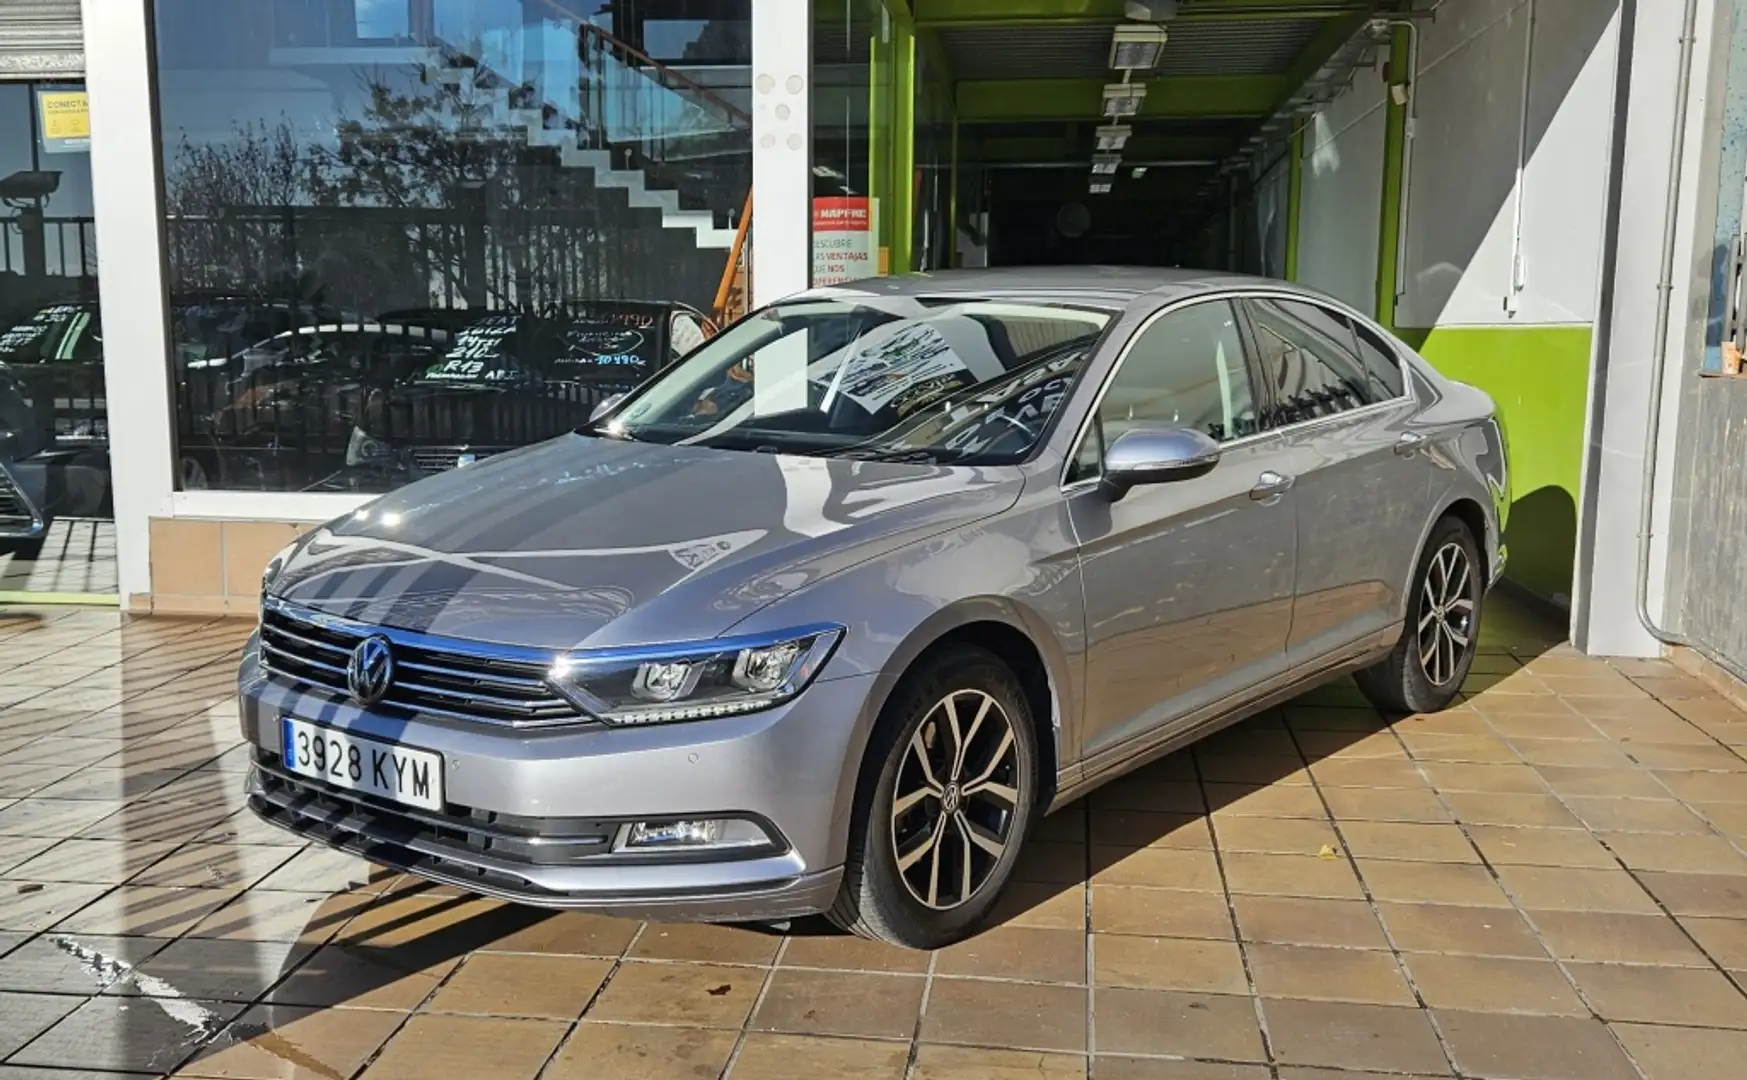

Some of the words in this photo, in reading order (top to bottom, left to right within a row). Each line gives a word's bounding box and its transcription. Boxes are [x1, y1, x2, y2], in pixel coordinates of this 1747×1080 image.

[820, 208, 867, 218] MAPFRE
[826, 251, 868, 262] VENTAJAS
[827, 263, 845, 273] NOS
[297, 731, 363, 782] 3928
[371, 748, 430, 800] KYM
